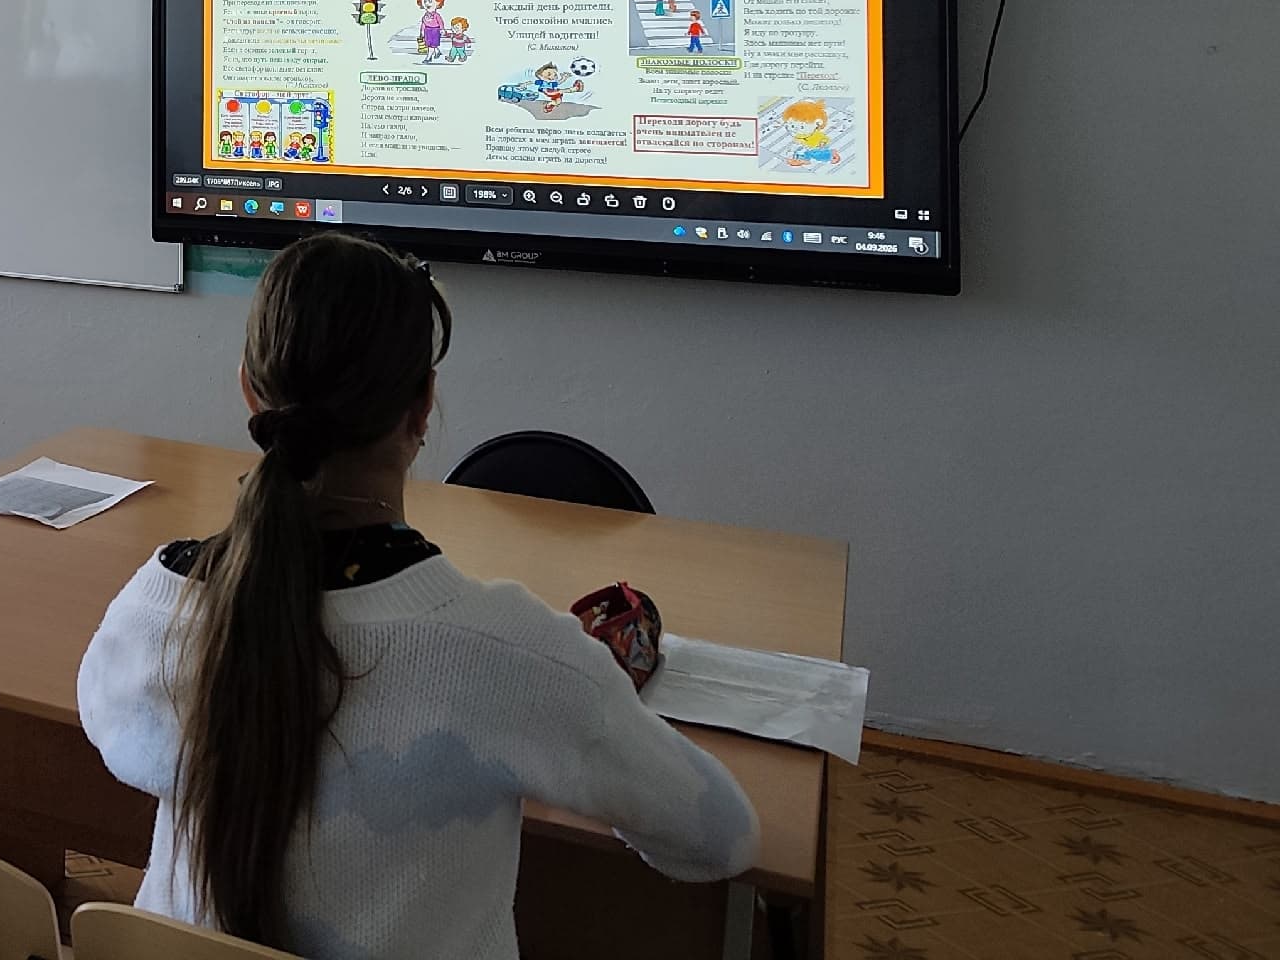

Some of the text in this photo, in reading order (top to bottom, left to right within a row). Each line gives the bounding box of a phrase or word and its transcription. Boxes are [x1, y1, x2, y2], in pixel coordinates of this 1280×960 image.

[494, 3, 533, 12] Каждый
[537, 4, 560, 12] день
[508, 31, 545, 40] Улицей
[398, 185, 412, 196] 2/6
[474, 189, 496, 200] 198%
